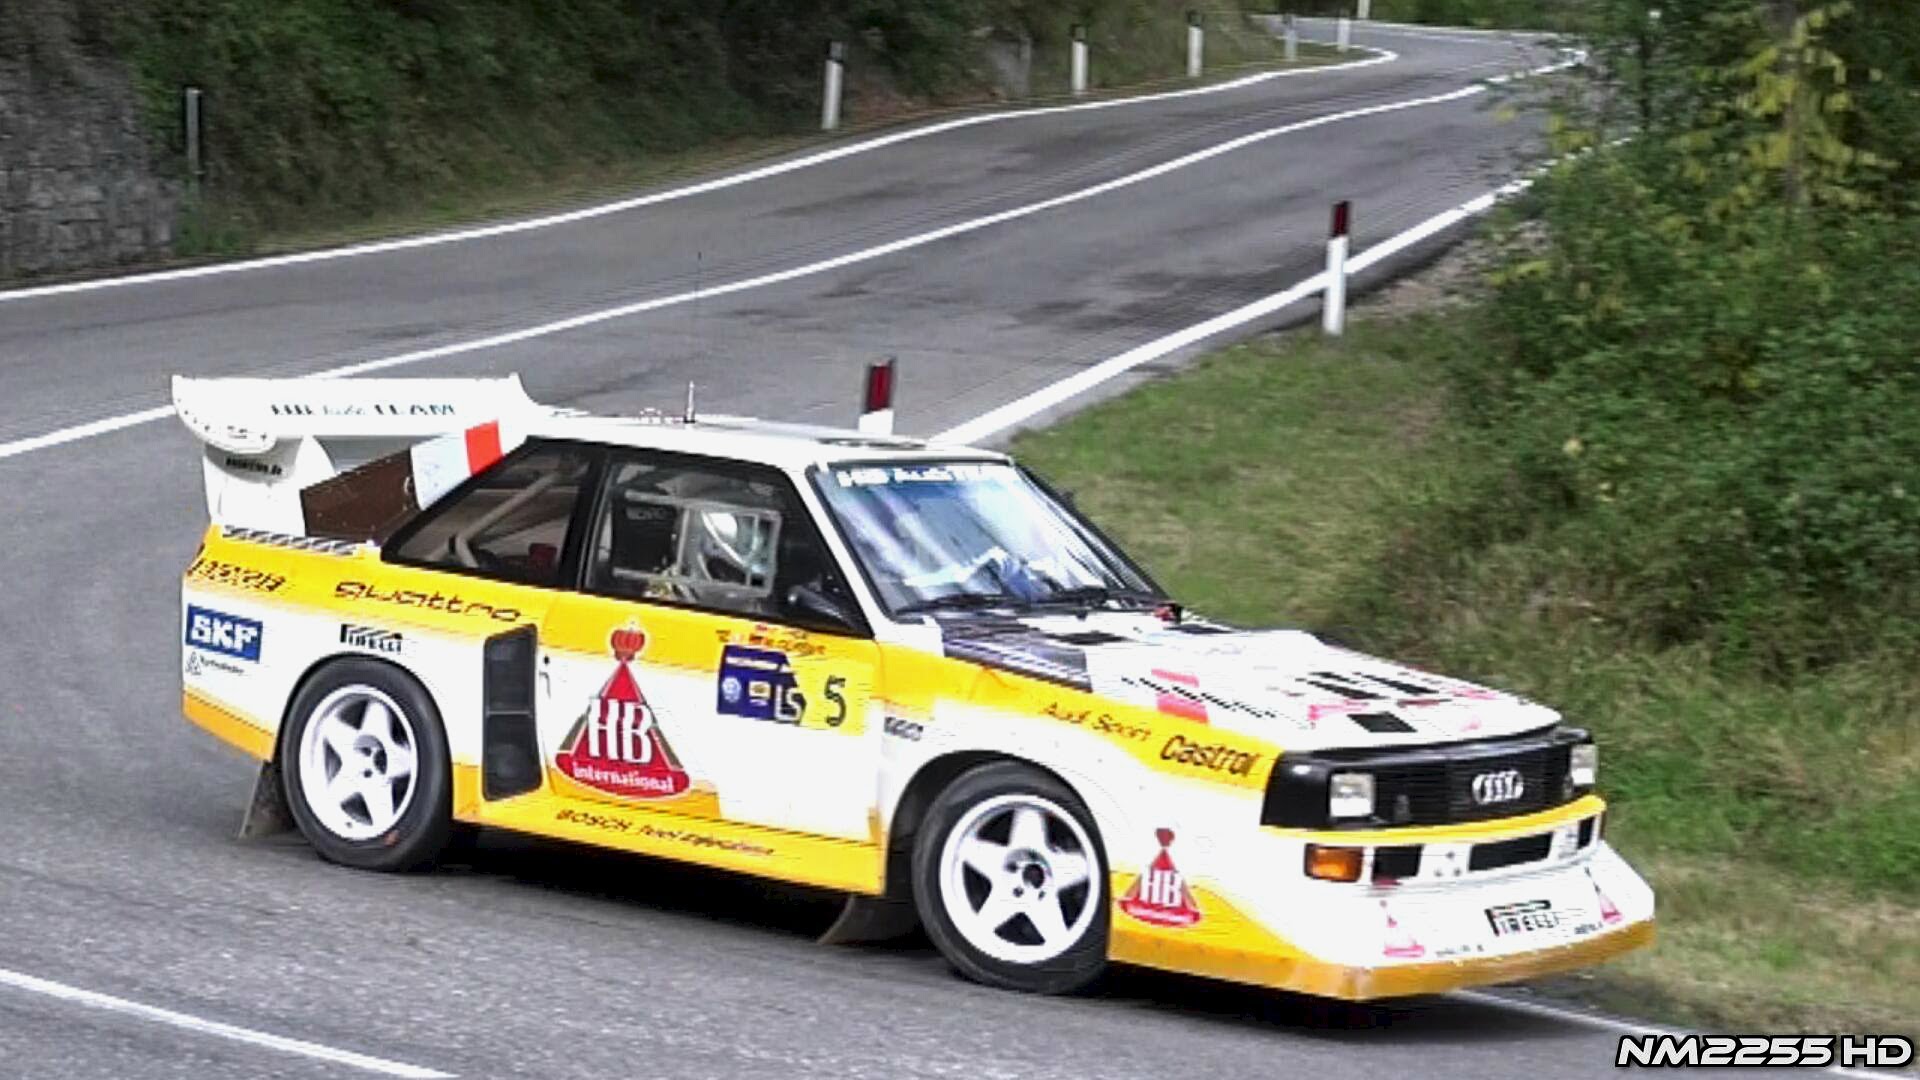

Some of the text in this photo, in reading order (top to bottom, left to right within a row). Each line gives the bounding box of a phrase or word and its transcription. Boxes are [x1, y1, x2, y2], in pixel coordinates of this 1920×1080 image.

[191, 613, 259, 652] SKF
[339, 623, 404, 653] PIRELLI
[823, 674, 848, 728] 5
[587, 697, 653, 764] HB
[1159, 734, 1261, 777] Castrol
[572, 761, 674, 793] international
[1138, 867, 1184, 908] HB
